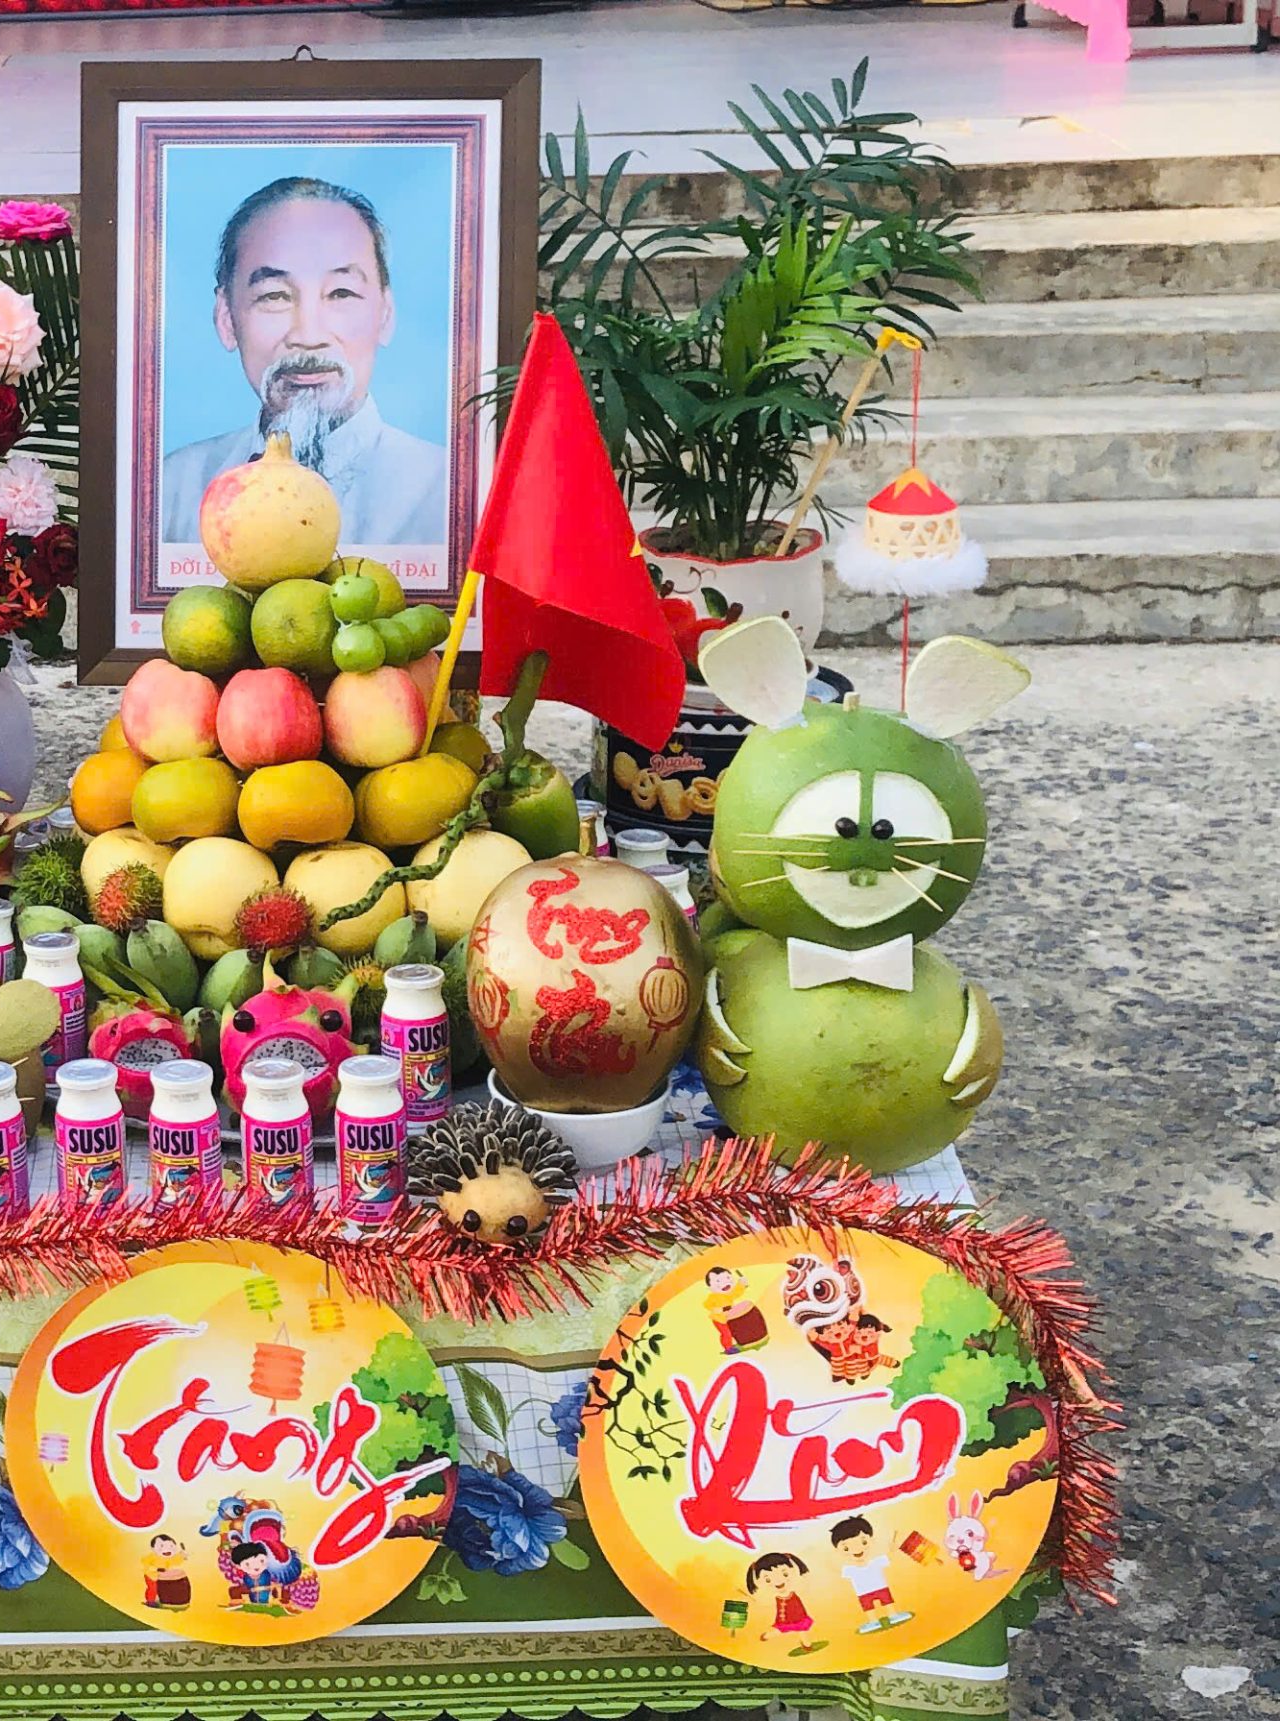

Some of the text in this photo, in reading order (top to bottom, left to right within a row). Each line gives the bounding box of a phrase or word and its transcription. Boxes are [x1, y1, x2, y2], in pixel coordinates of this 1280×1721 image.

[406, 563, 437, 580] ĐẠI
[408, 1021, 448, 1052] SUSU
[69, 1125, 117, 1153] SUSU
[153, 1126, 195, 1155] SUSU
[254, 1127, 299, 1155] SUSU
[347, 1123, 395, 1151] SUSU
[51, 1318, 451, 1568] Trăng
[674, 1361, 962, 1550] Rằm
